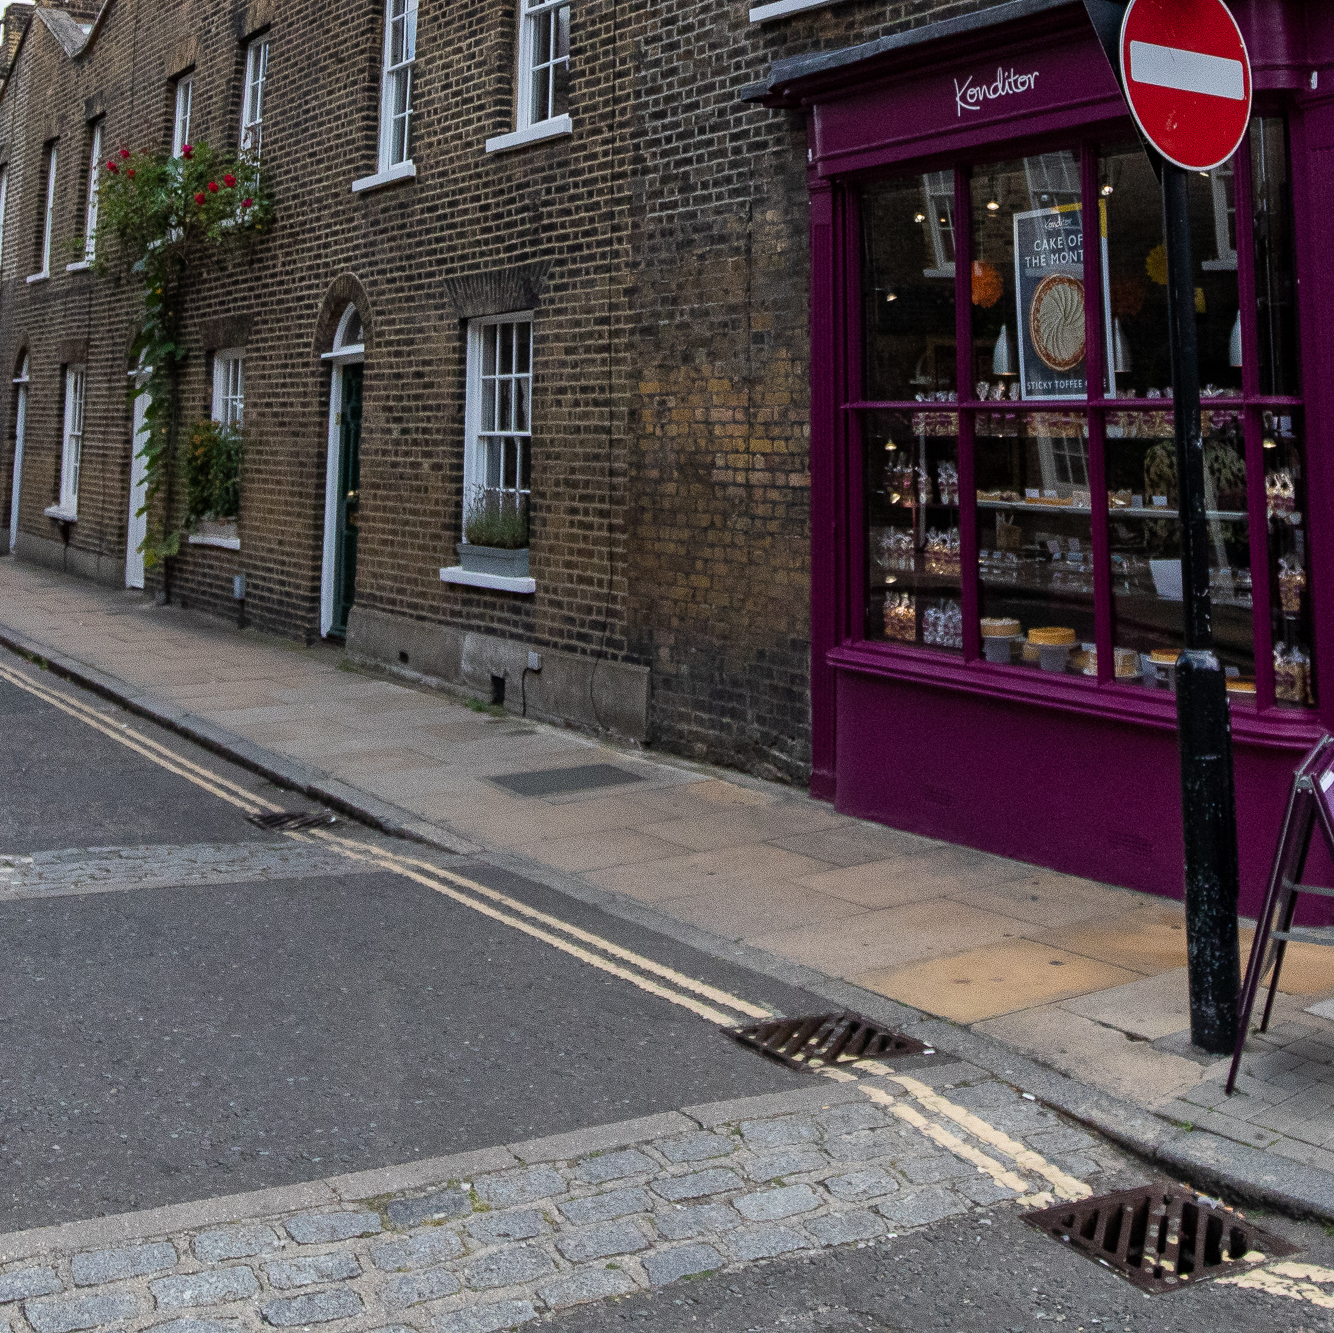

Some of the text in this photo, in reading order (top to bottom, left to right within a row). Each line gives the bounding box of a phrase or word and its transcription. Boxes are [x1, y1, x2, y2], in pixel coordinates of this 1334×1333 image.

[953, 66, 1040, 117] Konditor
[1034, 236, 1064, 252] CAKE
[1024, 249, 1083, 268] THE MONT
[1027, 381, 1053, 391] STICKY
[1054, 379, 1083, 389] TOFFEE
